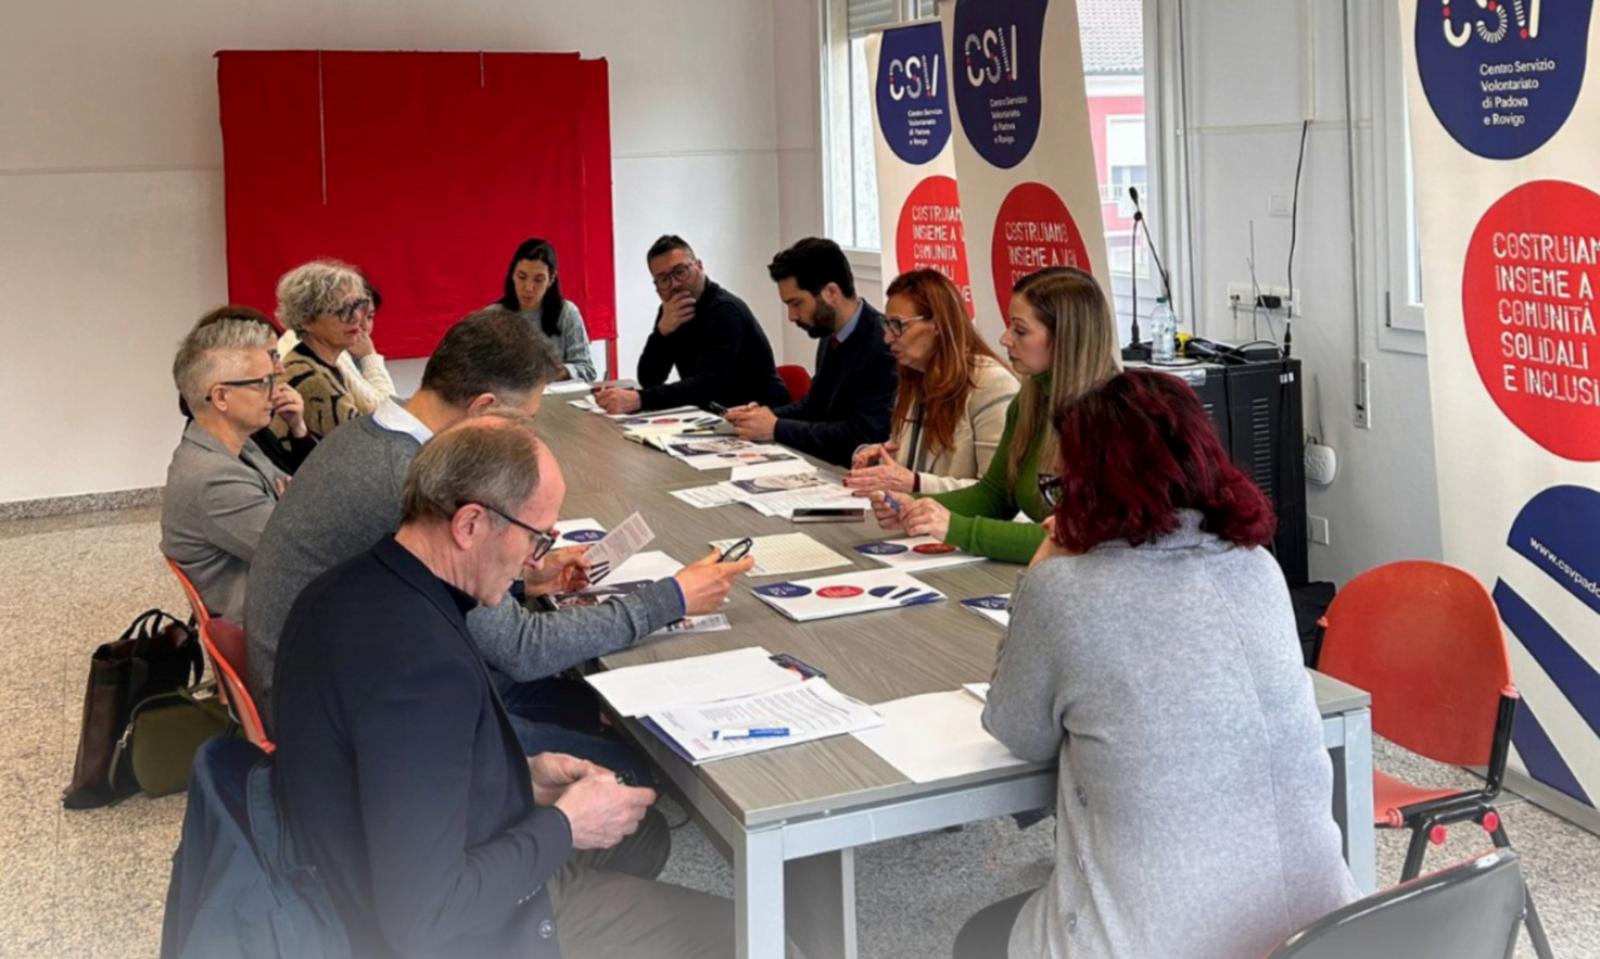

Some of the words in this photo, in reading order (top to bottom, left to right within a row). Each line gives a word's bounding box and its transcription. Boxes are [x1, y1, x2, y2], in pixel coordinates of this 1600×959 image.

[964, 24, 1018, 87] CSV
[889, 53, 939, 101] CSV
[1480, 63, 1513, 76] Centro
[1515, 58, 1555, 72] Servizio
[1481, 77, 1539, 92] Volontariato
[1482, 98, 1493, 109] di
[1494, 96, 1528, 109] Padova
[1483, 117, 1491, 125] e
[1492, 113, 1525, 127] Rovigo
[912, 224, 948, 241] INSIEME
[950, 226, 957, 241] A
[1005, 221, 1069, 243] COSTRUIAMO
[1008, 246, 1048, 267] INSIEME
[1051, 248, 1060, 268] A
[1495, 265, 1571, 299] INSIEME
[1578, 271, 1594, 300] A
[1498, 298, 1597, 336] COMUNITÀ
[1501, 331, 1589, 370] SOLIDALI
[1503, 364, 1518, 392] E
[1523, 366, 1600, 407] INCLUSI
